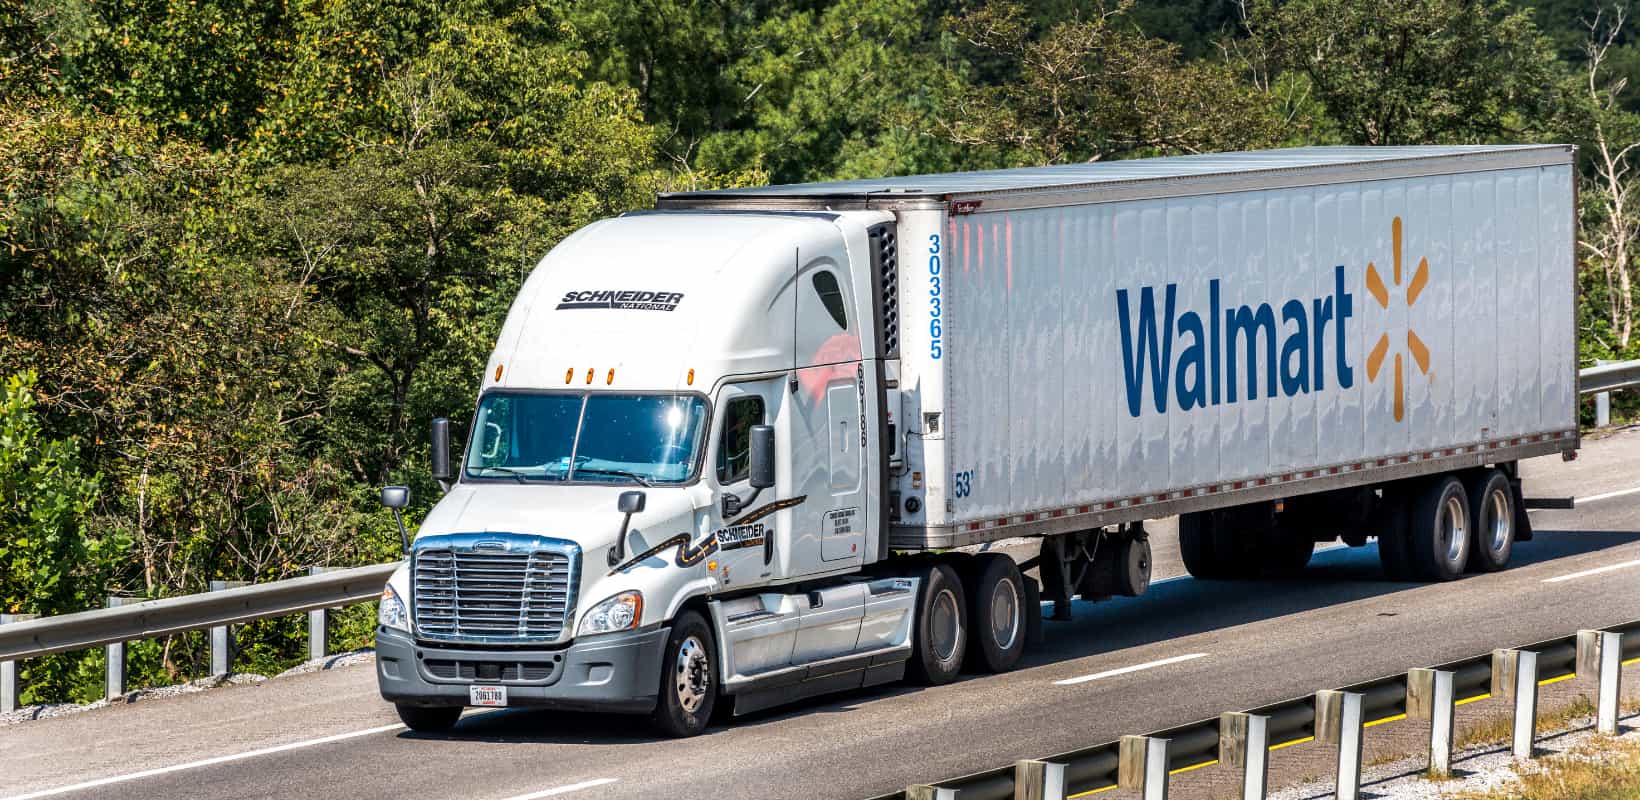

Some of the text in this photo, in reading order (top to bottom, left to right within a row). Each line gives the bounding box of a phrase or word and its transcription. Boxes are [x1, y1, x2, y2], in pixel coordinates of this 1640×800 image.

[562, 290, 685, 304] SCHNEIDER
[622, 302, 676, 312] NATIONAL
[929, 234, 942, 360] 303365
[1116, 265, 1353, 418] Walmart
[717, 523, 765, 543] SCHNEIDER
